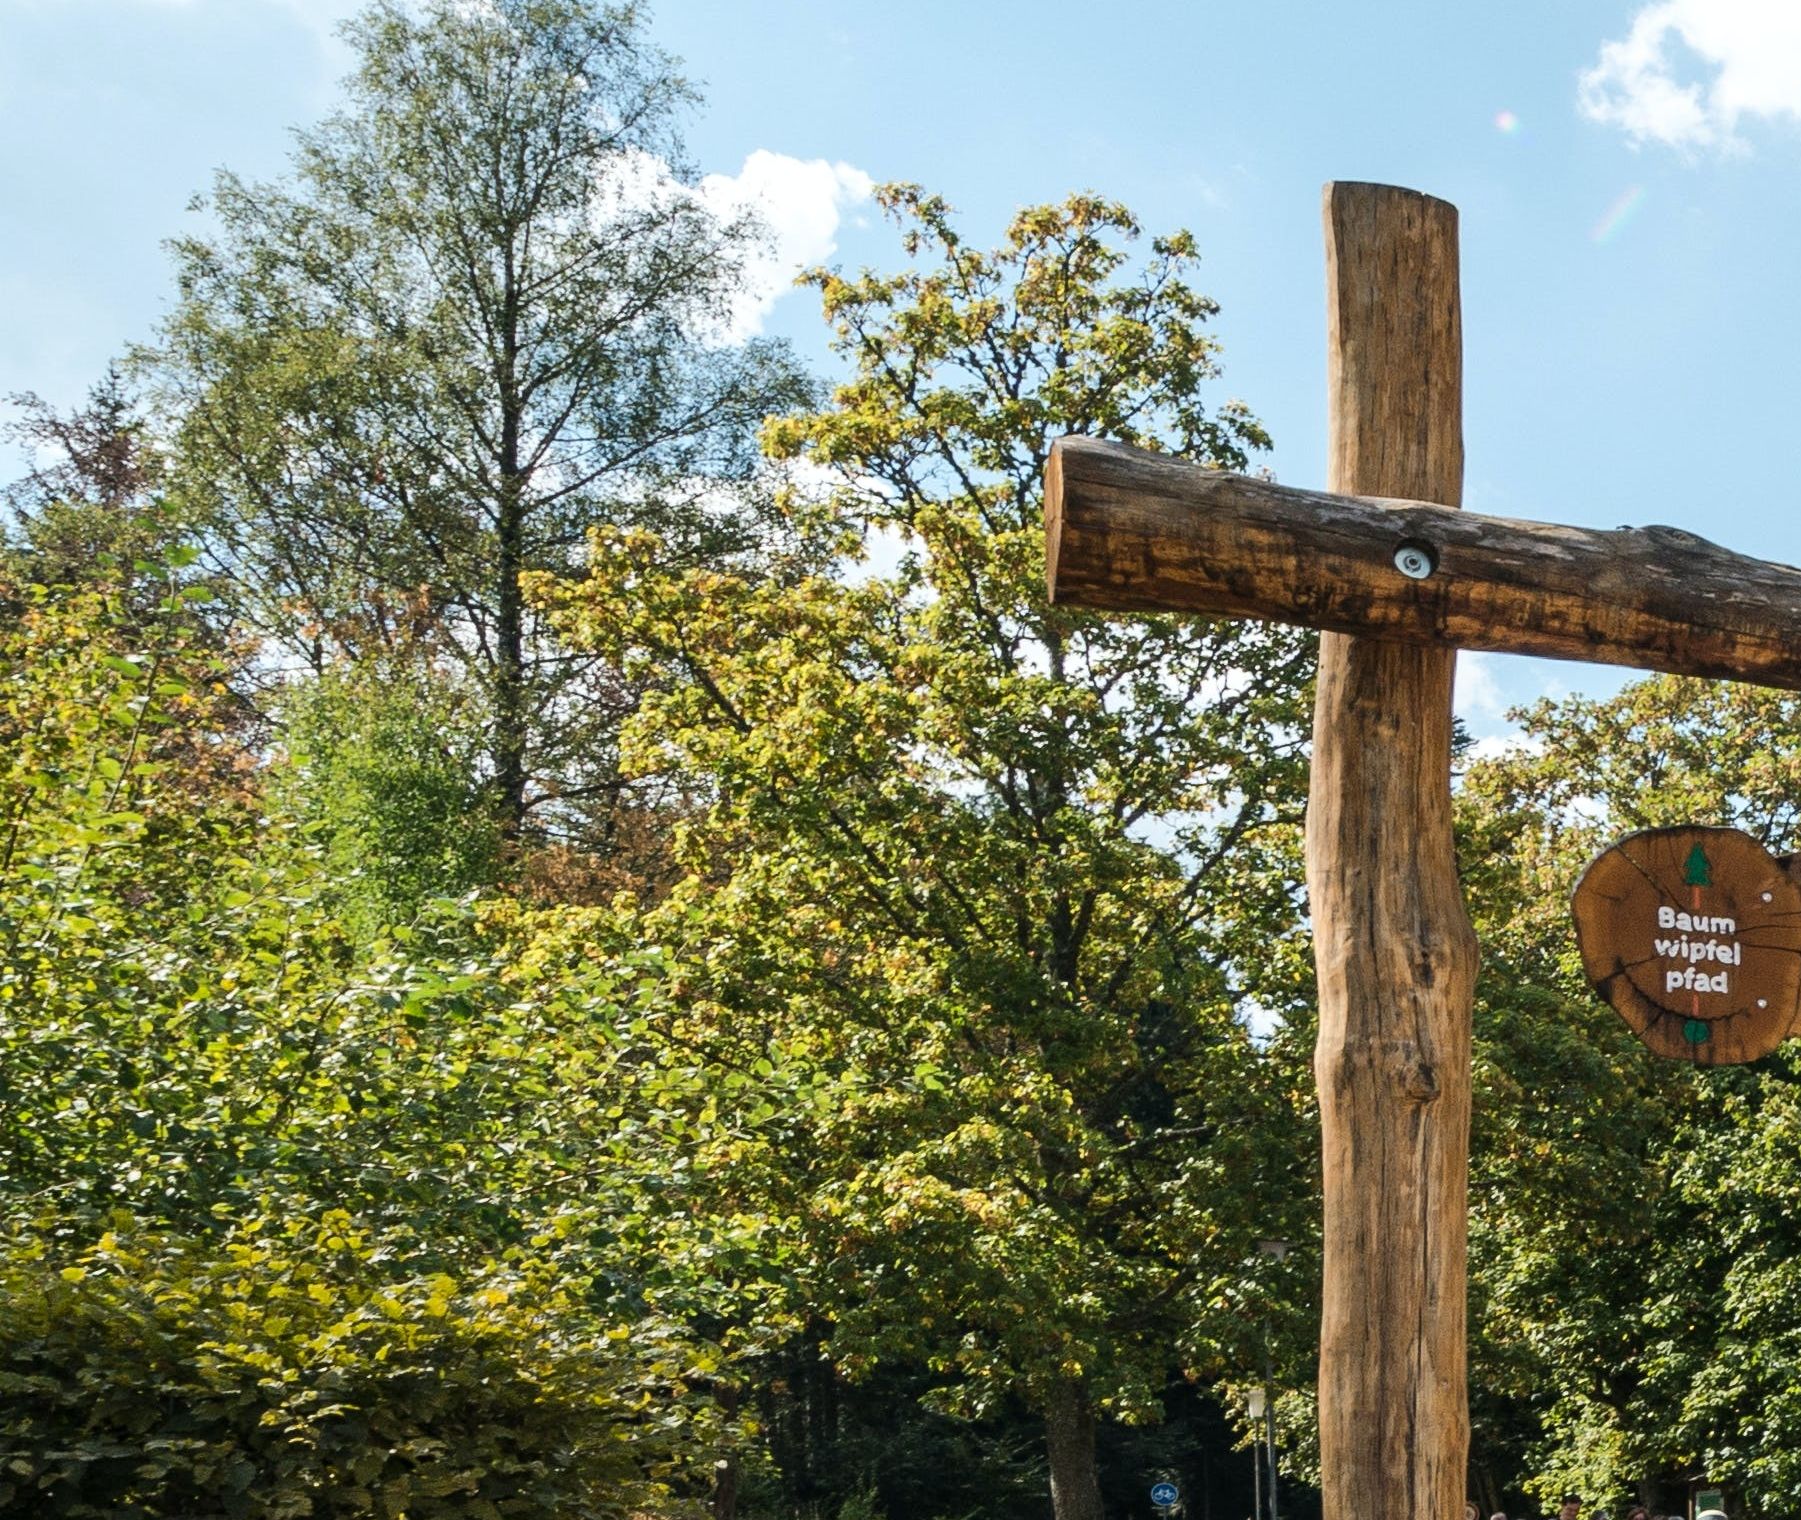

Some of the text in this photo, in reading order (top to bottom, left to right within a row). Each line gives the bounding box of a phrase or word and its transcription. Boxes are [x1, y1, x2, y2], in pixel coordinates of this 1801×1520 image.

[1658, 906, 1736, 934] Baum
[1654, 934, 1741, 966] wipfel
[1666, 966, 1728, 994] pfad
